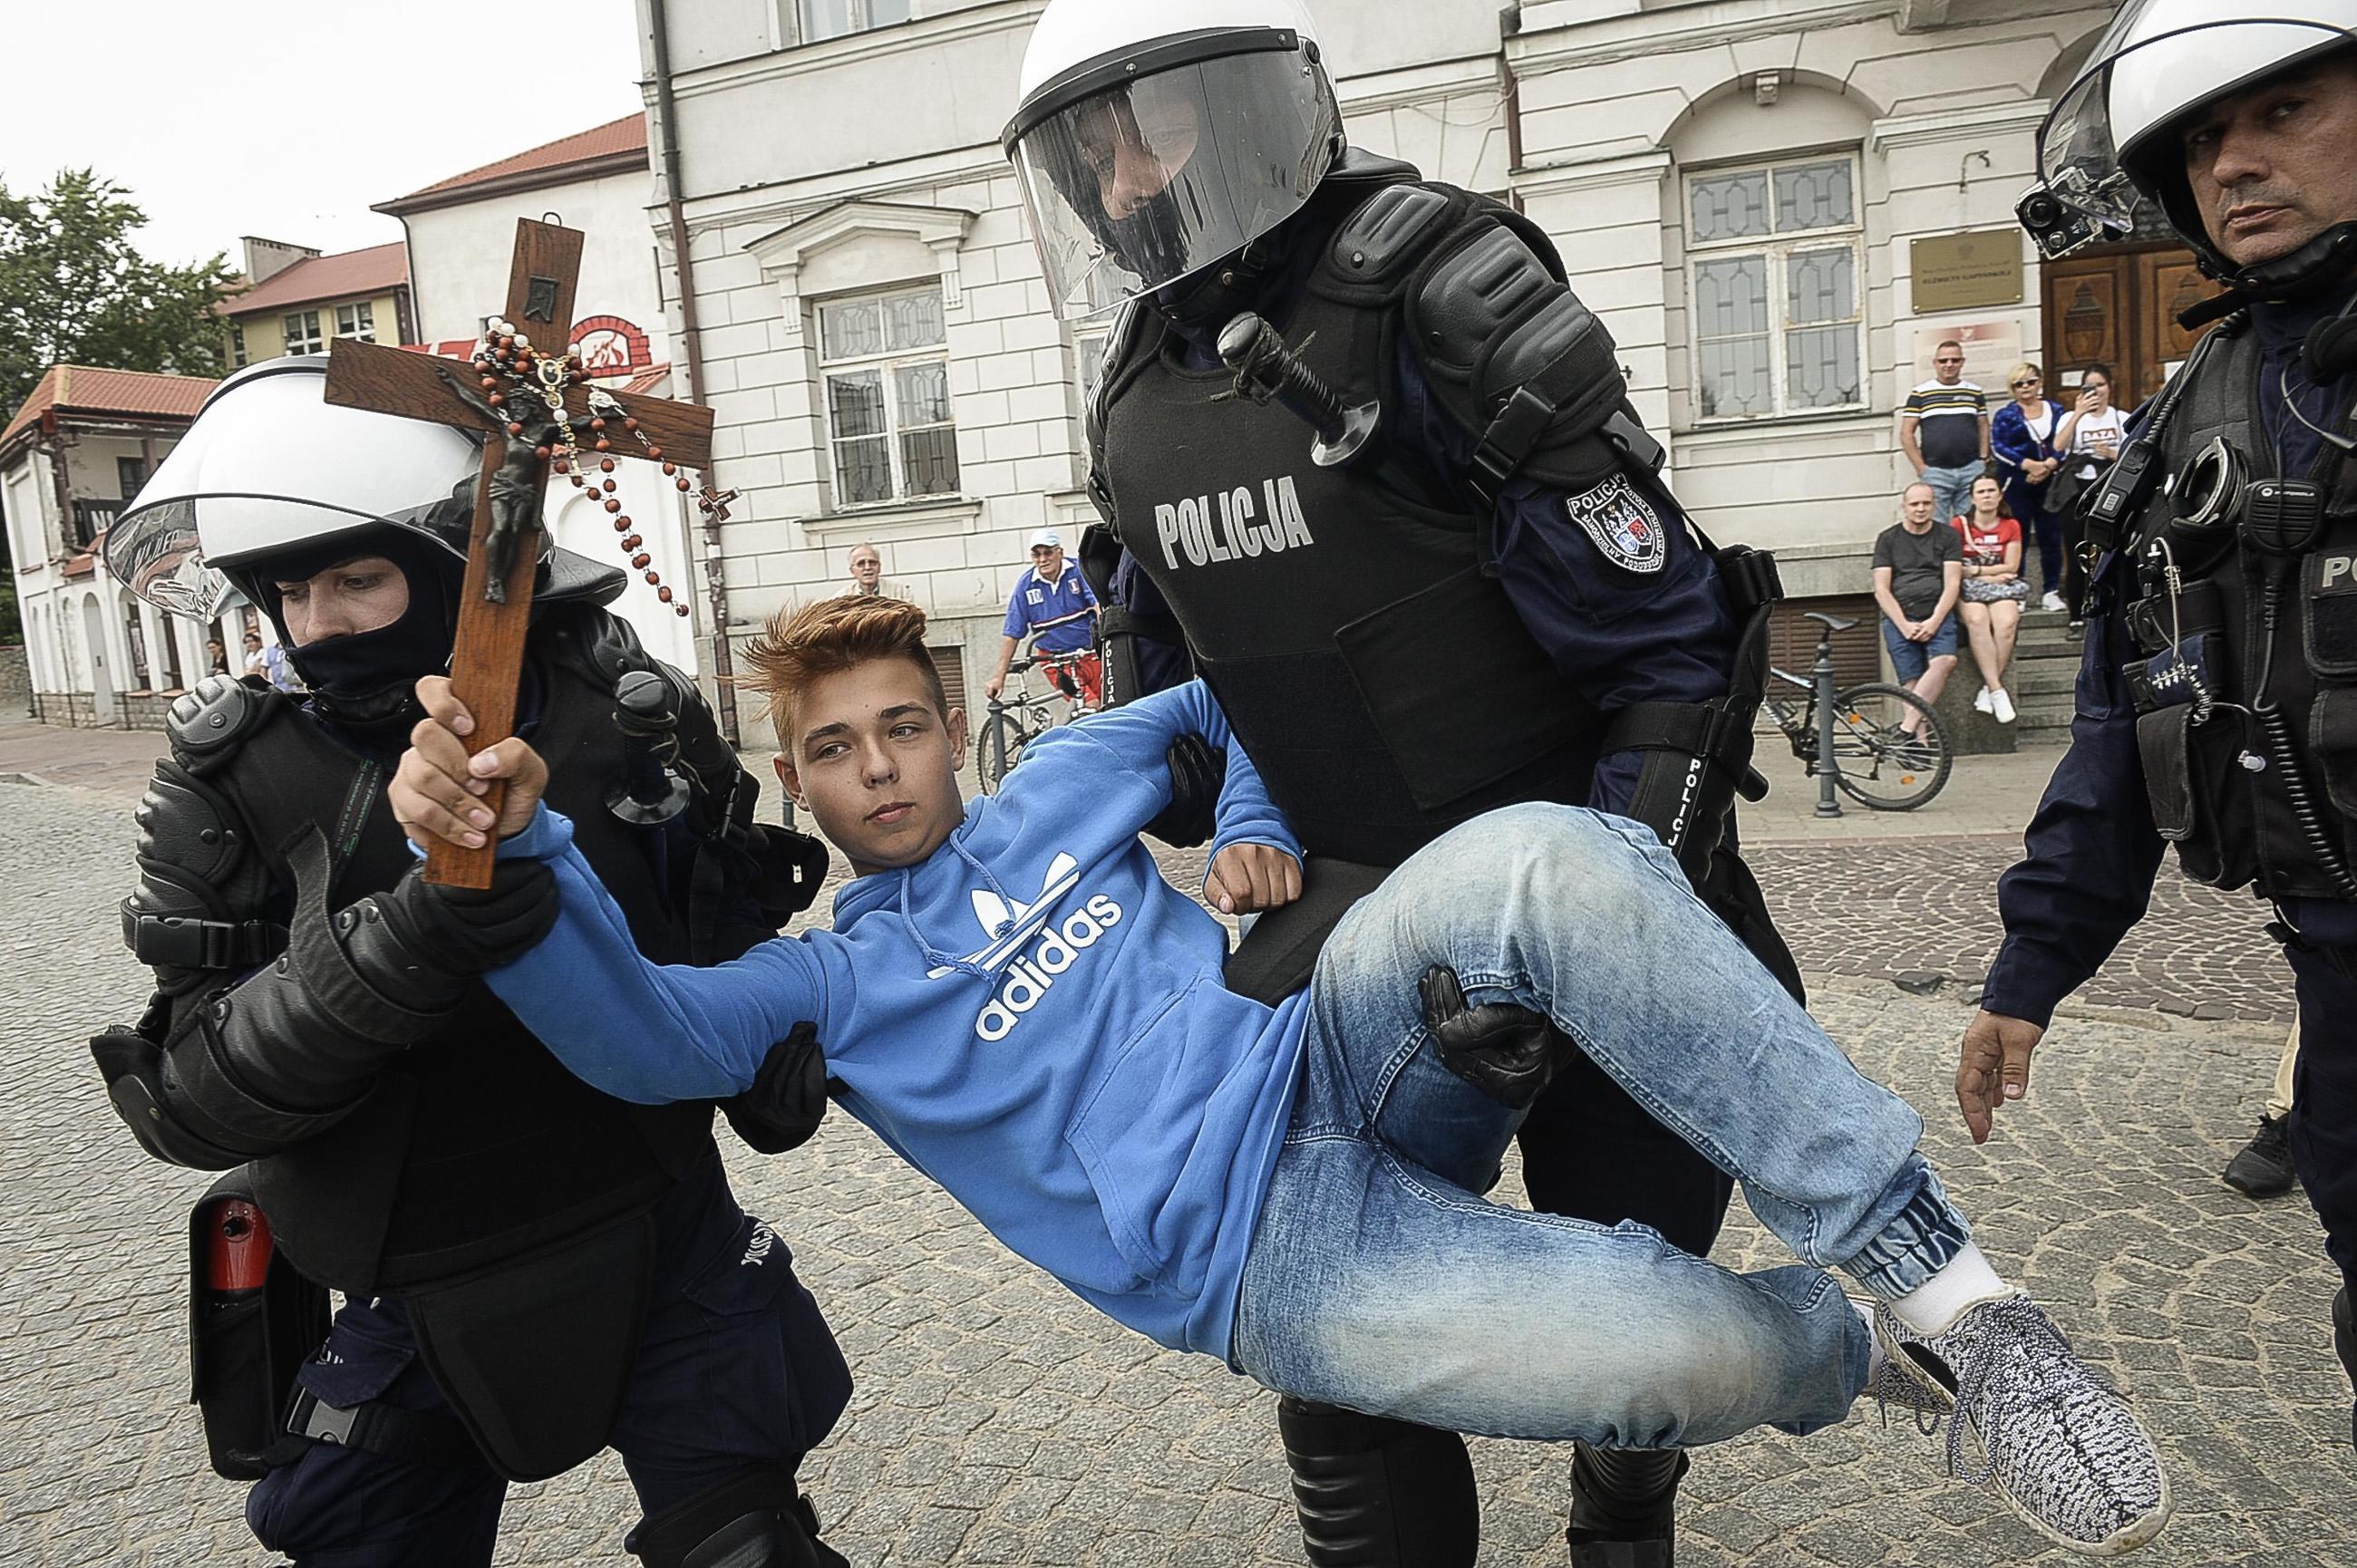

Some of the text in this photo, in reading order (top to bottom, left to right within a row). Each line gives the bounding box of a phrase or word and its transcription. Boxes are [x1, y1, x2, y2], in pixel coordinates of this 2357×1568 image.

[1154, 476, 1314, 569] POLICJA
[1570, 472, 1624, 515] POLICJA
[1030, 591, 1043, 603] 10
[2323, 557, 2357, 588] P
[1106, 640, 1115, 703] POLICJA
[1668, 759, 1702, 846] POLICJ
[975, 894, 1123, 1042] adidas
